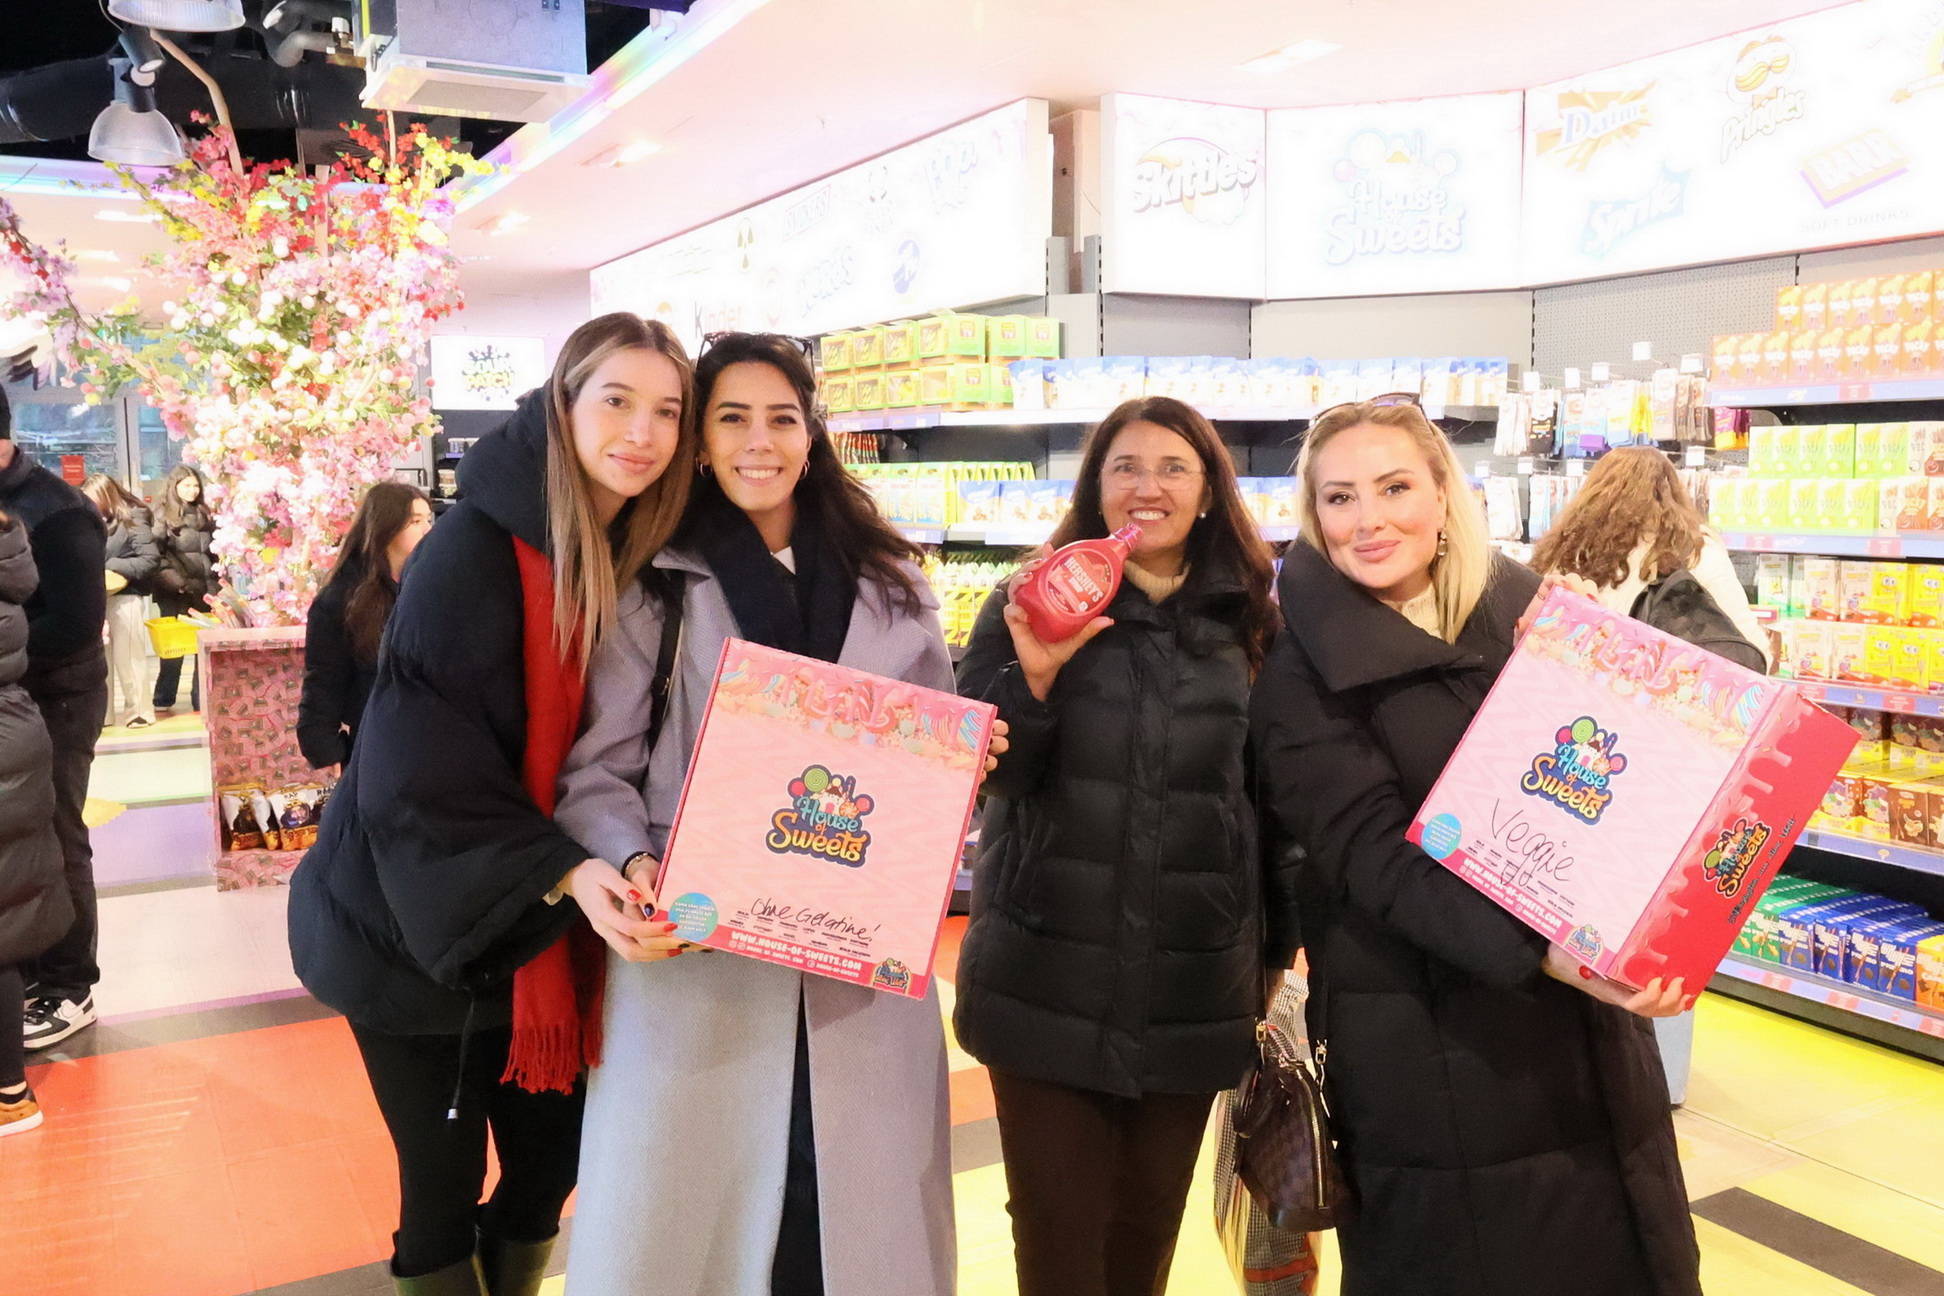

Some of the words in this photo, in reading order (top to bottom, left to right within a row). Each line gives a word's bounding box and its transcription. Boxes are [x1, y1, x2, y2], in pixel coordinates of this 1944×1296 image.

[1562, 102, 1639, 146] Daim
[1720, 87, 1806, 164] Pringles
[1132, 151, 1258, 213] Skittles
[1348, 176, 1448, 217] House
[1323, 202, 1467, 266] Sweets
[1800, 218, 1842, 233] SOFT
[1847, 209, 1911, 227] DRINKS
[1063, 555, 1104, 602] HERSHEY'S
[1523, 755, 1610, 819] Sweets
[1557, 744, 1607, 789] House
[768, 811, 868, 862] Sweets
[796, 796, 859, 832] House
[1491, 798, 1574, 887] Veggie
[1716, 829, 1753, 876] House
[1718, 823, 1768, 896] Sweets
[731, 930, 862, 971] WWW.HOUSE-OF-SWEETS.COM
